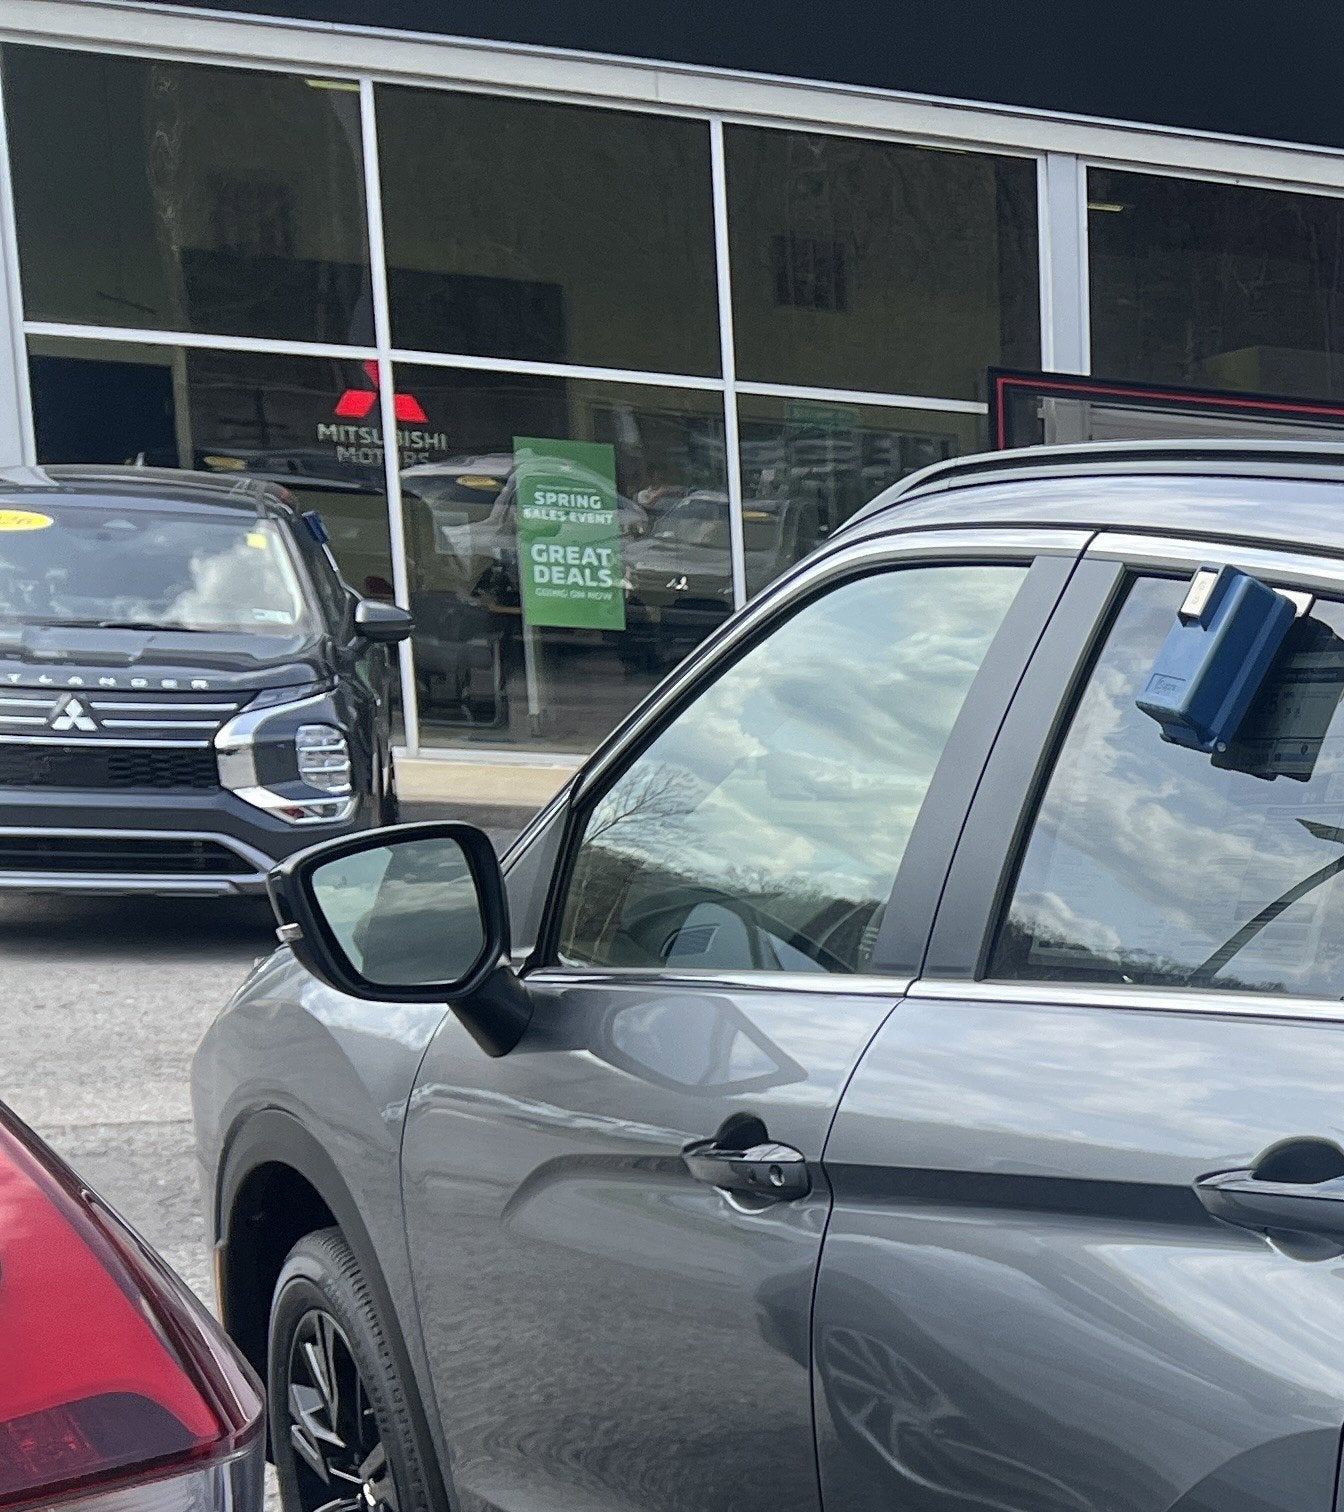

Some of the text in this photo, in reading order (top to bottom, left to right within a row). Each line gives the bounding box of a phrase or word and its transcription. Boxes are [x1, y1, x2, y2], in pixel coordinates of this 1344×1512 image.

[316, 422, 449, 451] MITSUISHI
[336, 445, 430, 466] MOTRS
[533, 491, 601, 510] SPRING
[522, 507, 613, 525] SALES EVENT
[530, 543, 612, 566] GREAT
[533, 565, 614, 588] DEALS
[7, 672, 210, 690] TLANDER
